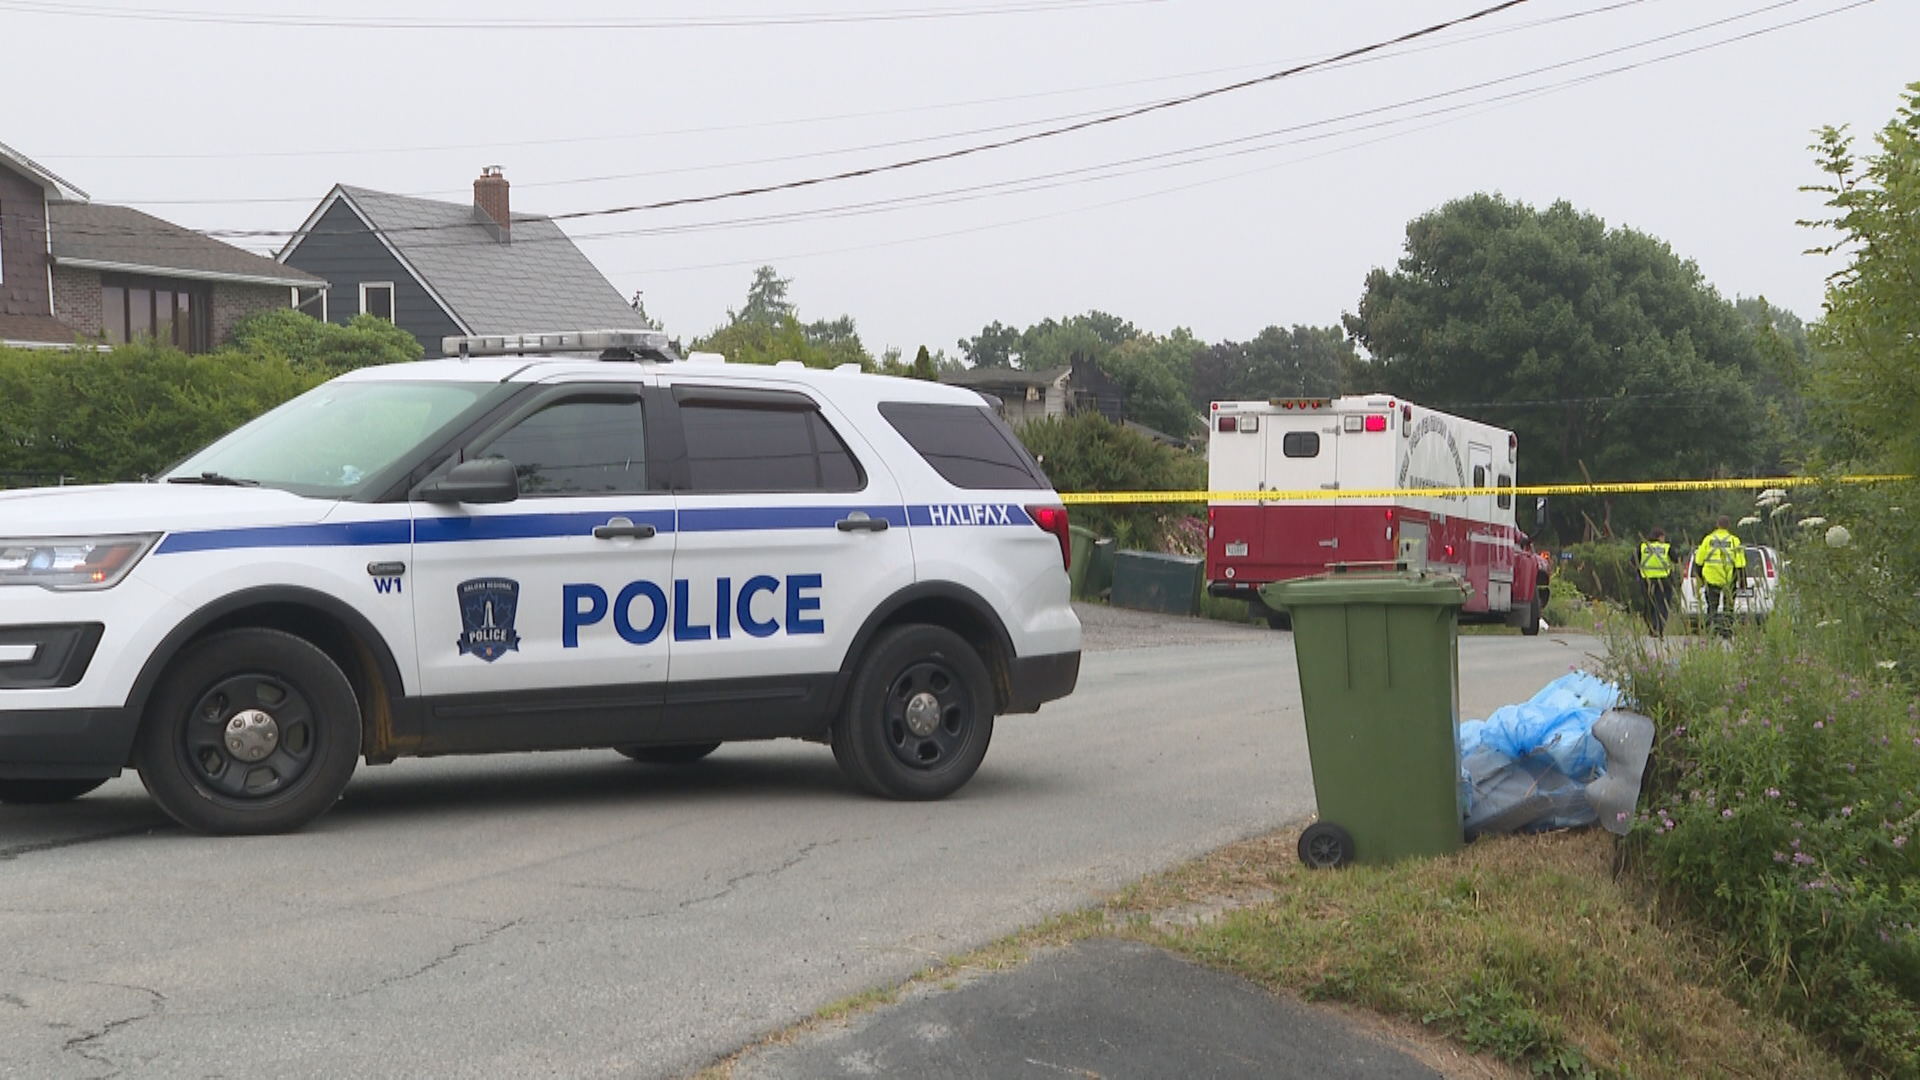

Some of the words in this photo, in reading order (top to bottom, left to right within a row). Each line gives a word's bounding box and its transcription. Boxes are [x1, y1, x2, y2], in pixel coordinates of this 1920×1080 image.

[928, 504, 1012, 525] HALIFAX
[373, 576, 402, 594] W1
[464, 582, 485, 592] HALIFAX
[562, 573, 825, 648] POLICE
[468, 628, 508, 644] POLICE
